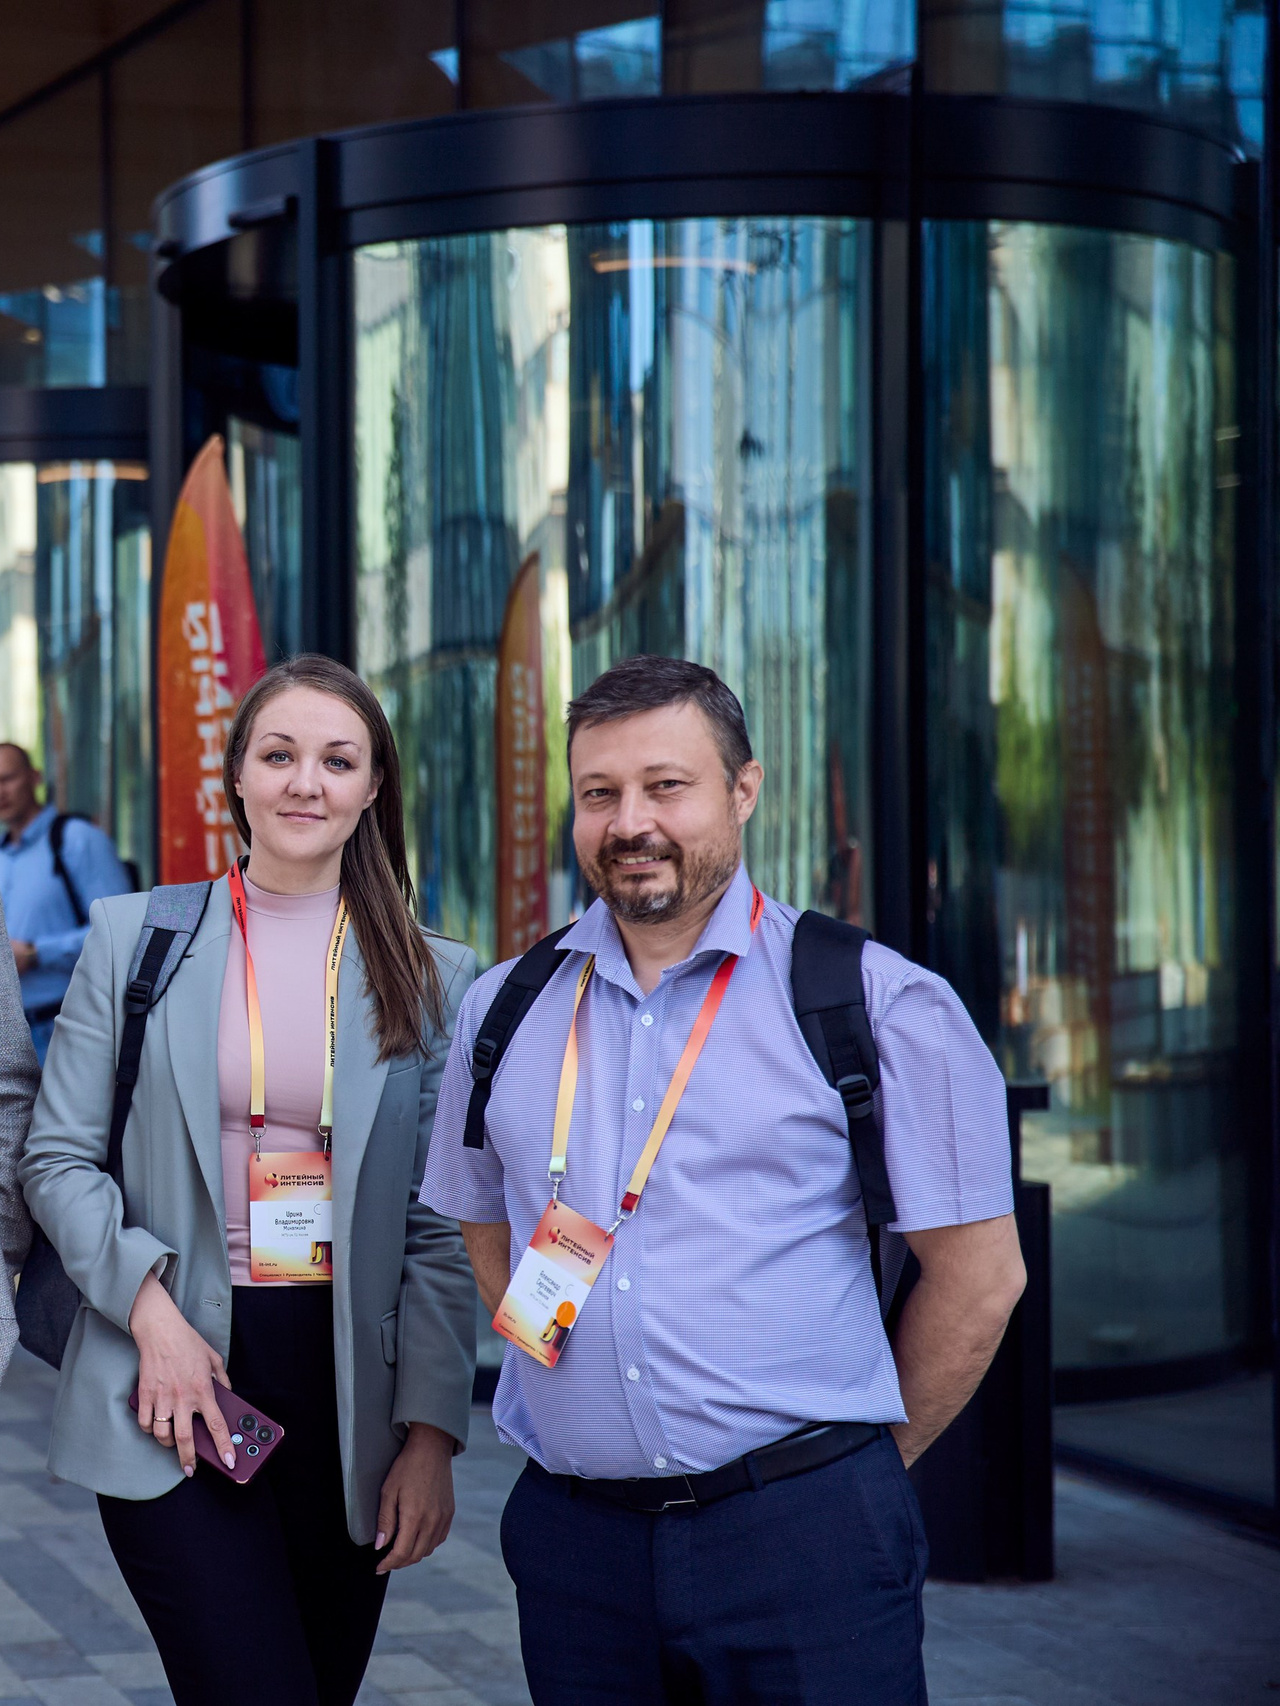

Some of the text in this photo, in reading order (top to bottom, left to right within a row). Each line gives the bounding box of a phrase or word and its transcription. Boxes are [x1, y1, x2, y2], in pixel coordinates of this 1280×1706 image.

[331, 936, 342, 971] ЛИТЕЙНЫЙ
[558, 1241, 592, 1266] ИНТЕНСИВ
[561, 1234, 595, 1260] ЛИТЕЙНЫЙ
